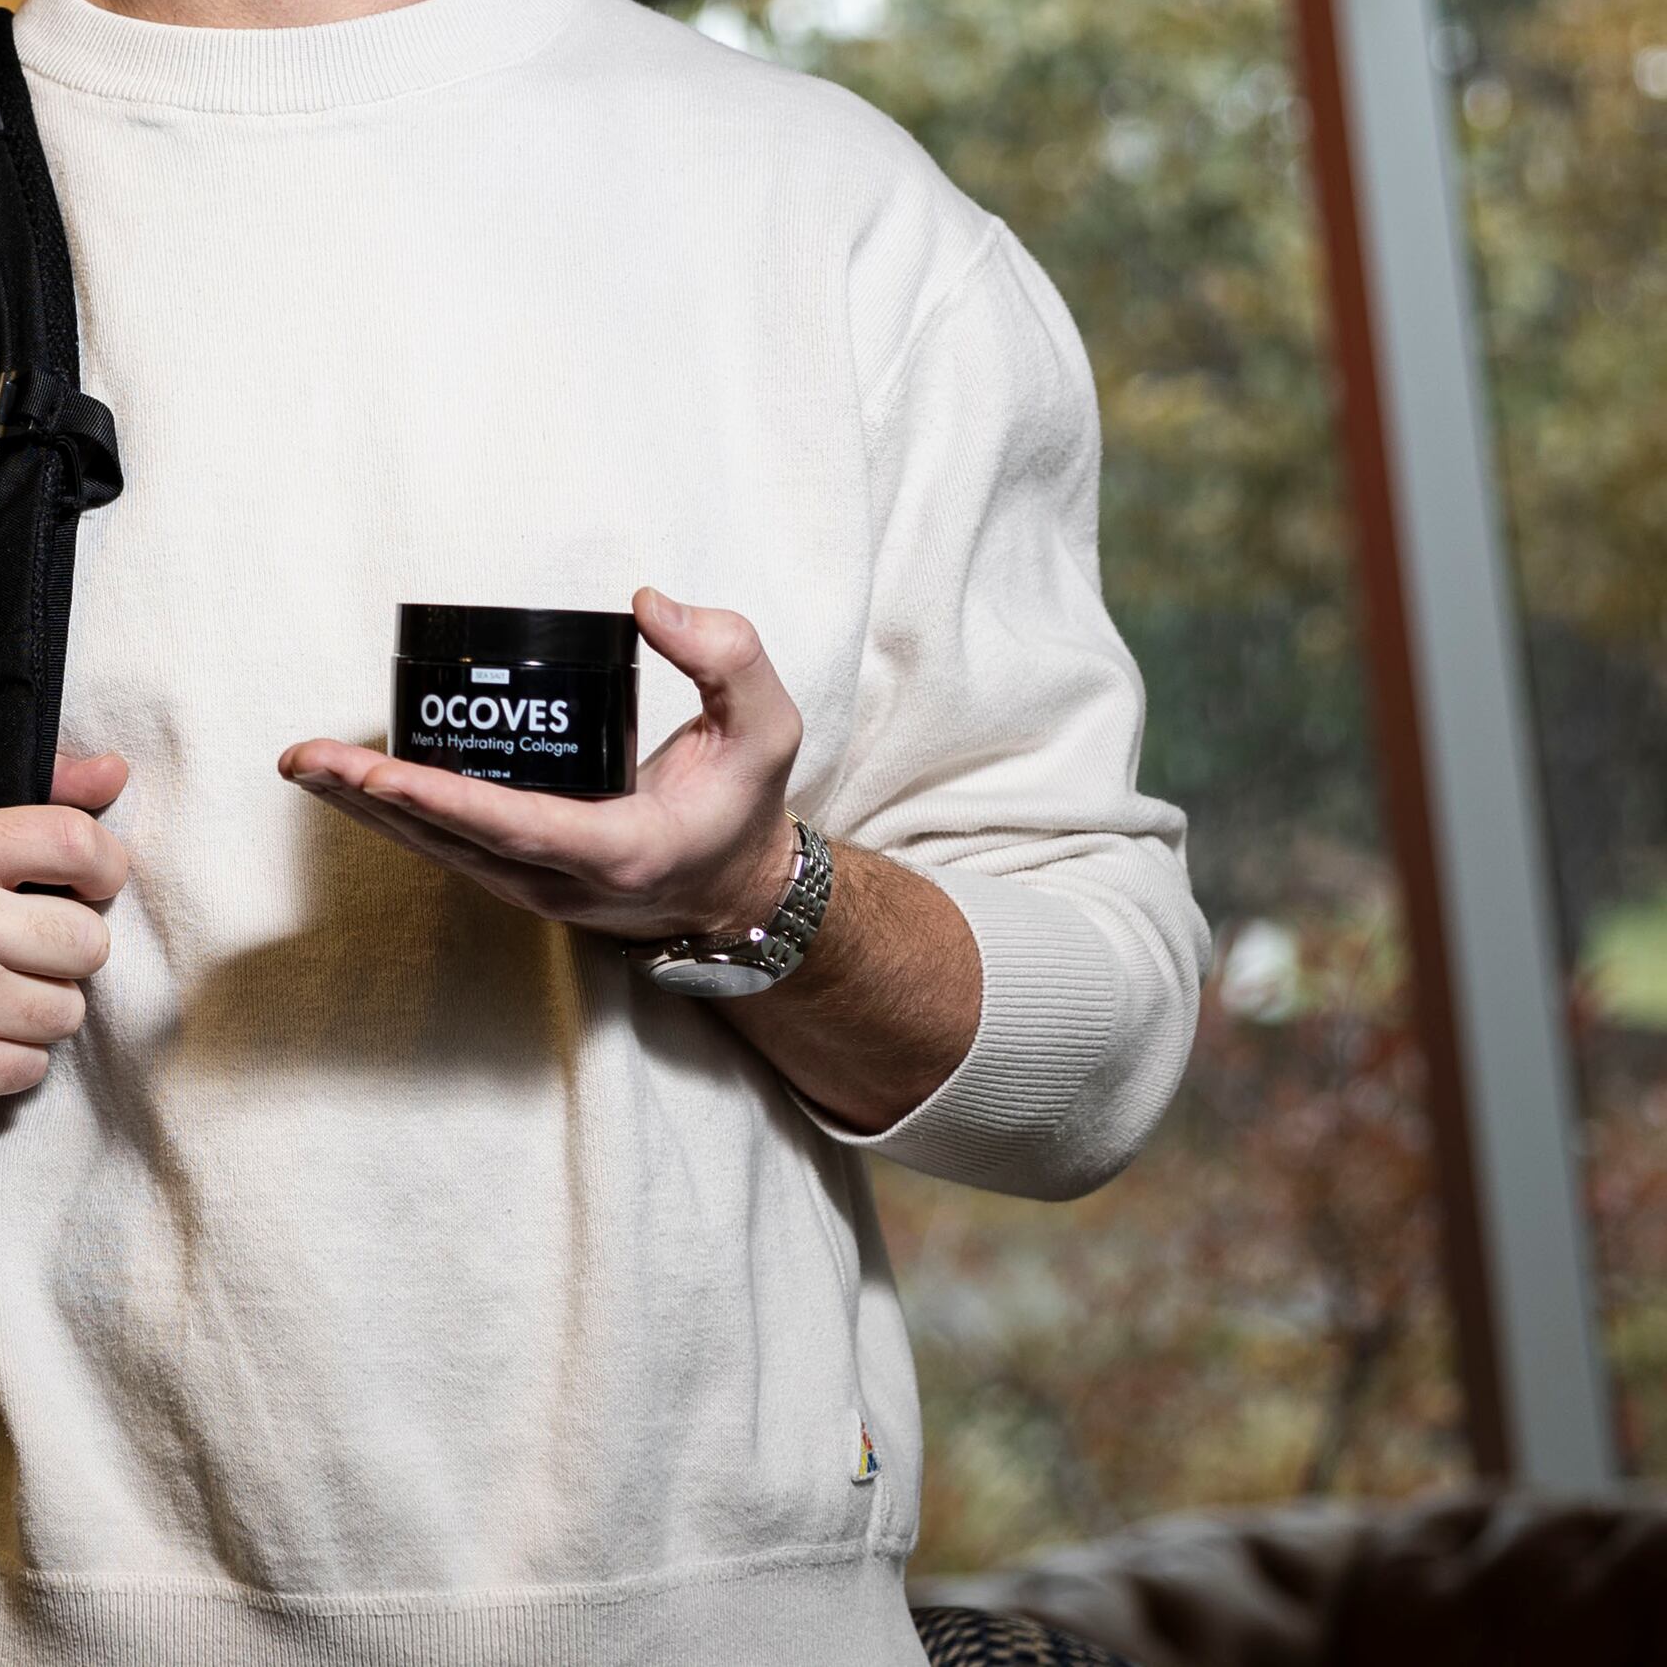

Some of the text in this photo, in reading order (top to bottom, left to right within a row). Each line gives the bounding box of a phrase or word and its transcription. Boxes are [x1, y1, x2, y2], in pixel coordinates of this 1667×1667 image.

[421, 694, 569, 733] OCOVES
[411, 733, 579, 757] Men's Hydrating Cologne
